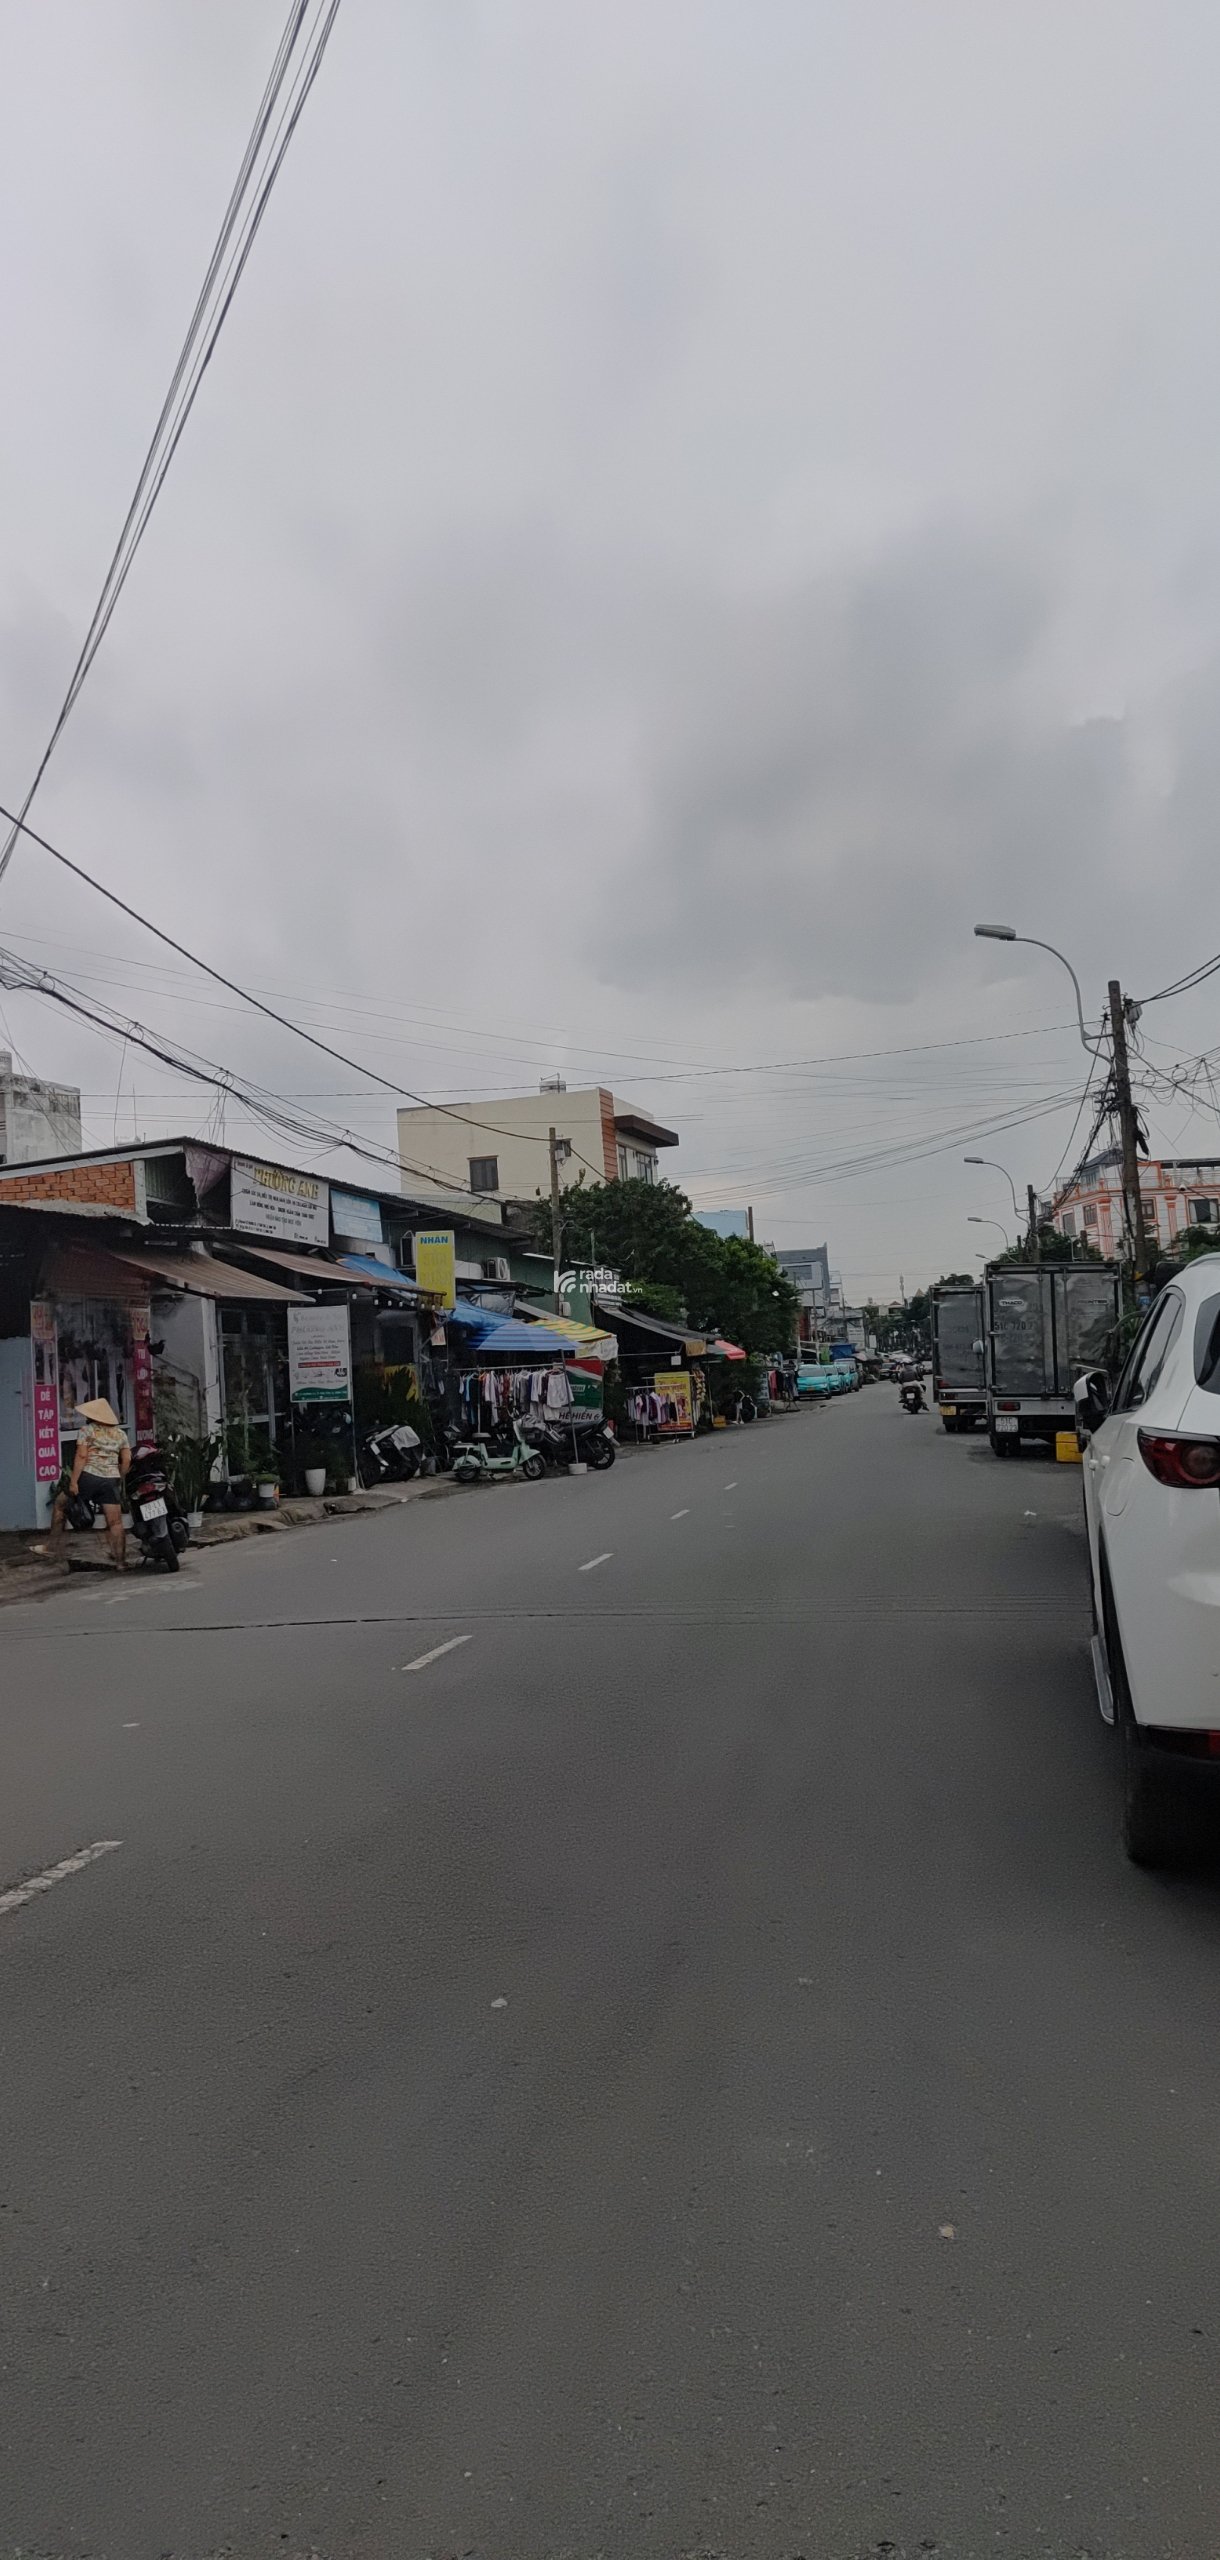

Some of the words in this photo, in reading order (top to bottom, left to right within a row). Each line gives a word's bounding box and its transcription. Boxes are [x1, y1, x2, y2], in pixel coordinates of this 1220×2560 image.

[297, 1181, 320, 1200] ANH
[420, 1235, 449, 1246] NHẬN
[39, 1465, 57, 1477] CAO
